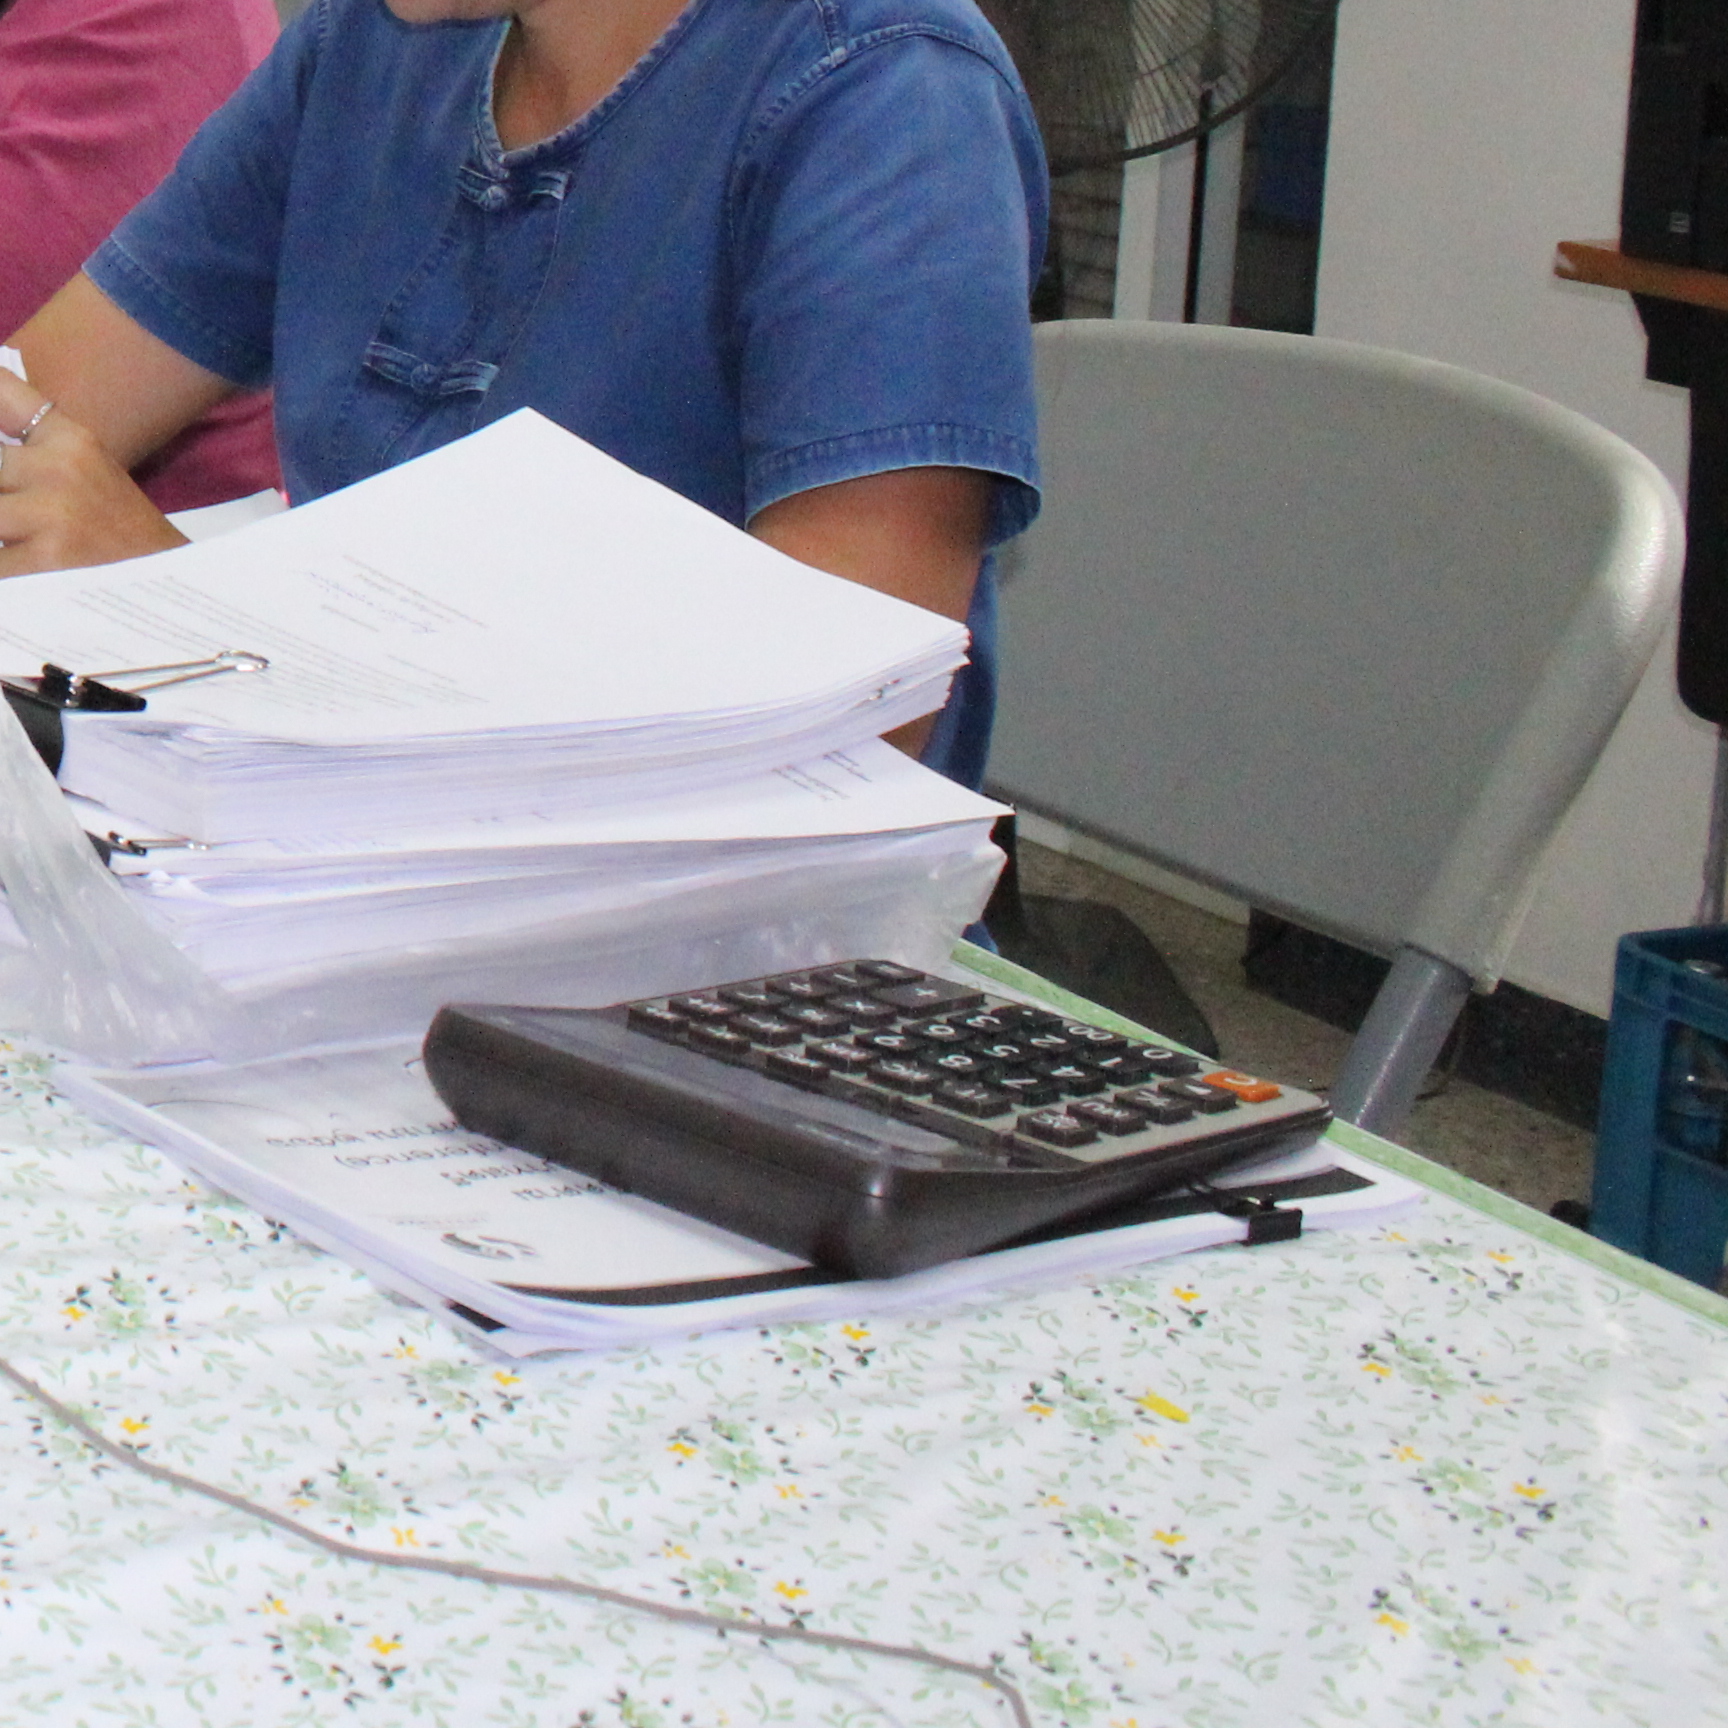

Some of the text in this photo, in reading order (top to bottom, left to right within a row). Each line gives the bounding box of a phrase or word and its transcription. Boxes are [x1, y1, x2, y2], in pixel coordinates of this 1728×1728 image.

[966, 1015, 1001, 1028] 3
[928, 1024, 955, 1036] 6
[1069, 1025, 1114, 1041] 00
[874, 1035, 905, 1047] 9
[1030, 1035, 1067, 1047] 2
[984, 1044, 1020, 1057] 5
[1142, 1048, 1173, 1060] 0
[938, 1054, 973, 1068] 8
[1098, 1056, 1123, 1068] 1
[1050, 1065, 1086, 1078] 4
[1000, 1077, 1038, 1089] 7
[1224, 1075, 1258, 1087] C
